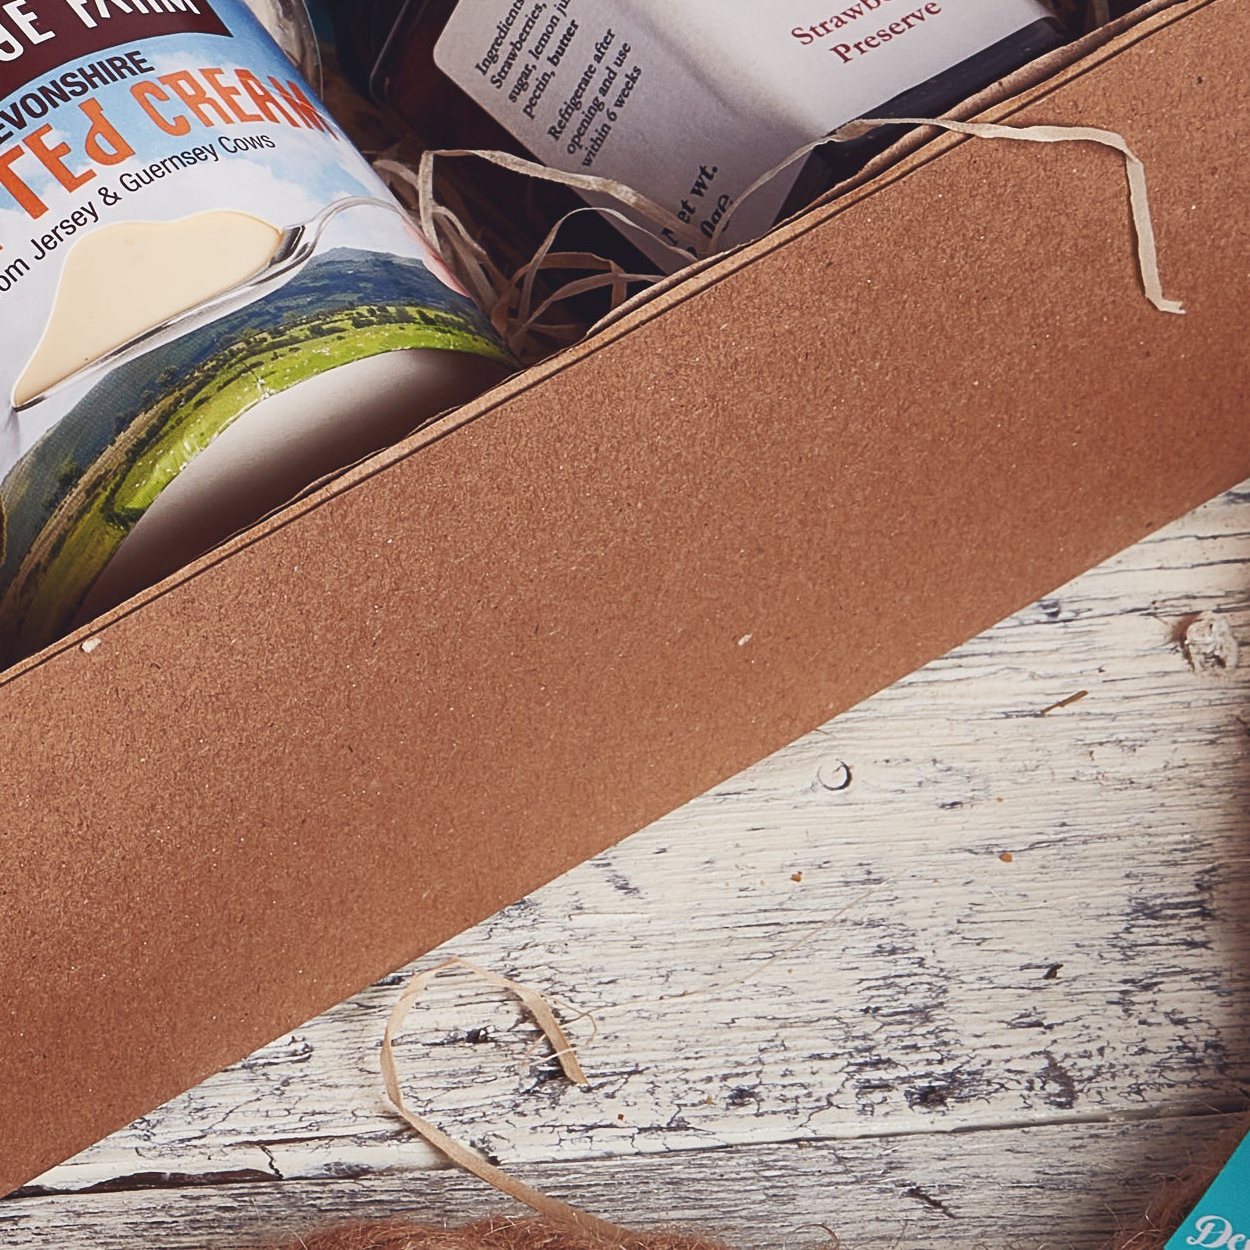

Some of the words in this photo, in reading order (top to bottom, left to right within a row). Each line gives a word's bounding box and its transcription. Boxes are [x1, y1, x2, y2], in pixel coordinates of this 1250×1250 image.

[490, 1, 547, 89] Strawberries,
[508, 62, 537, 103] sugar,
[531, 14, 560, 61] lemon
[522, 68, 556, 119] pectin,
[547, 18, 579, 68] butter
[829, 1, 942, 64] Preserve
[130, 67, 338, 141] CREAM
[547, 66, 598, 142] Refrigerate
[593, 28, 616, 65] after
[566, 94, 606, 155] opening
[598, 72, 619, 105] and
[615, 42, 632, 71] use
[581, 124, 612, 168] within
[607, 108, 618, 122] 6
[614, 65, 642, 109] weeks
[33, 200, 100, 262] Jersey
[97, 186, 122, 207] &
[120, 141, 218, 192] Guernsey
[218, 131, 276, 154] Cows
[690, 164, 718, 198] wt.
